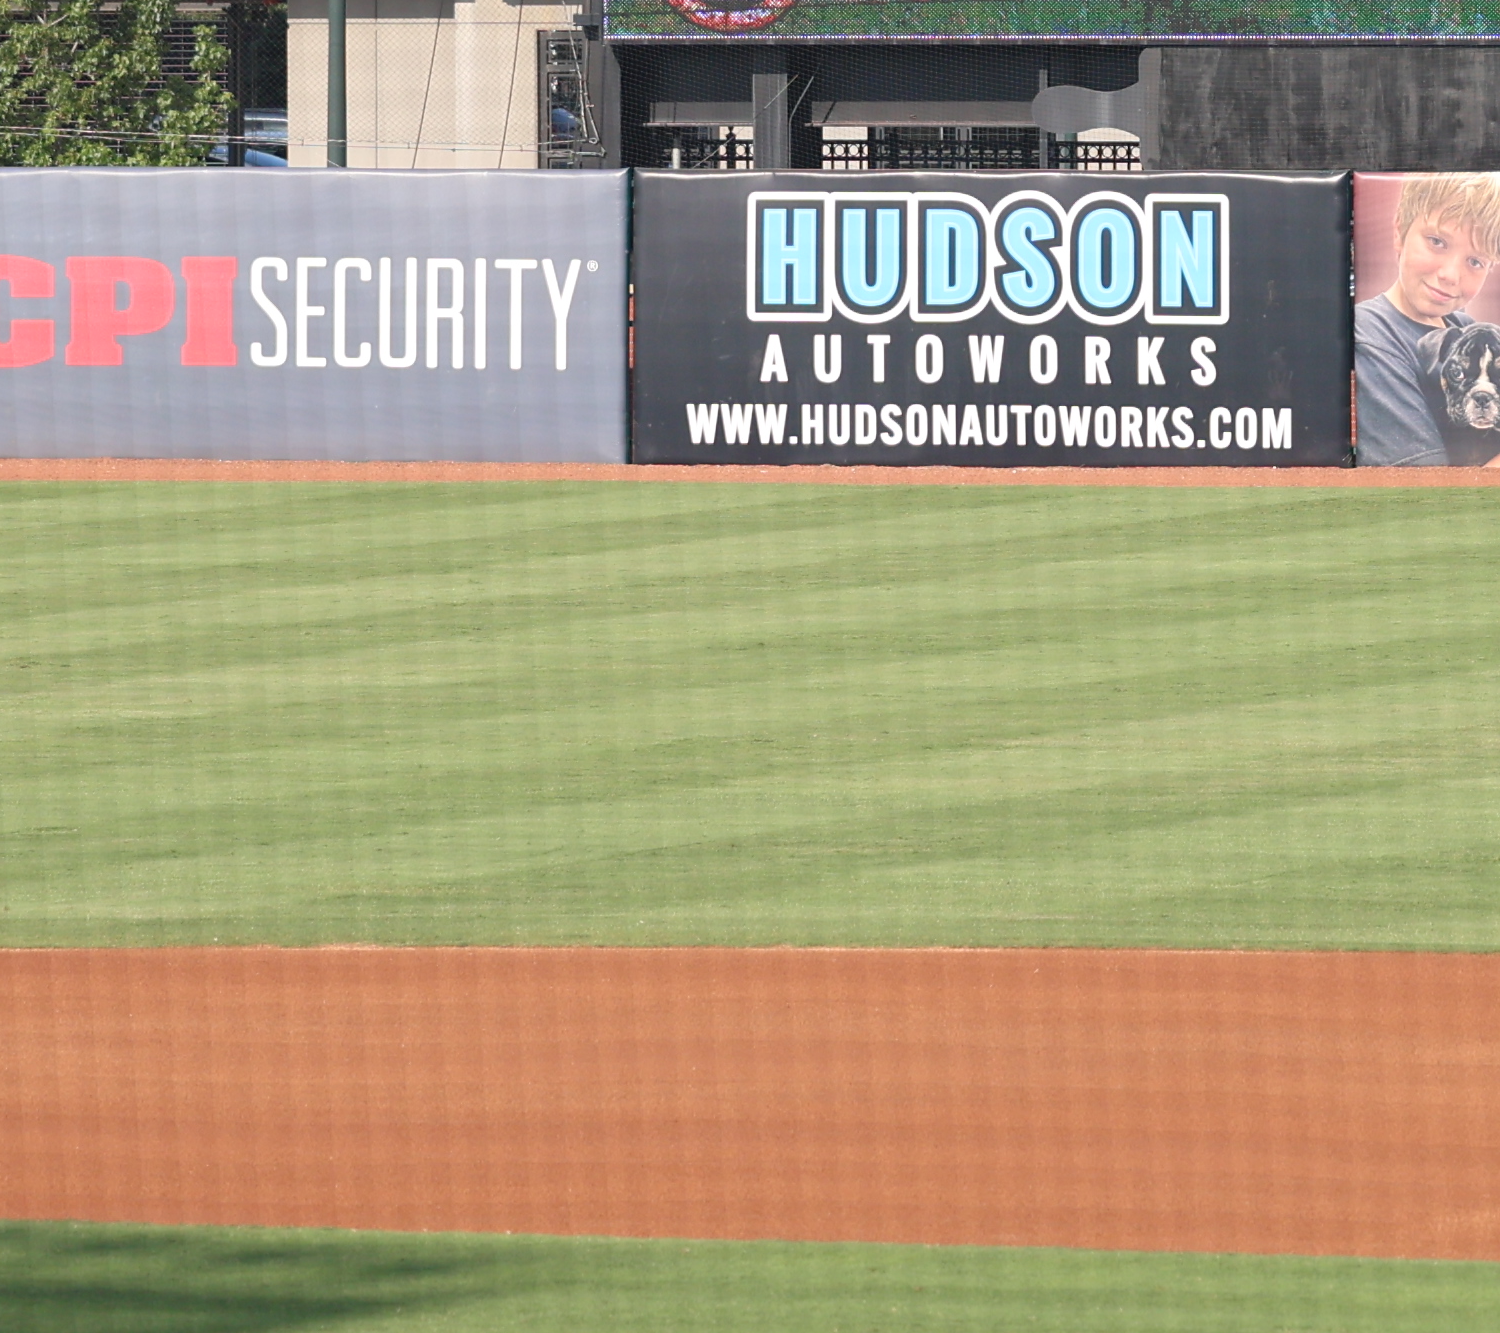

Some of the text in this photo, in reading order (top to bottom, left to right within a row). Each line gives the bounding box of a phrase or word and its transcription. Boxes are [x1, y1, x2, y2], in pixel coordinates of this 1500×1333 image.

[747, 190, 1229, 325] HUDSON
[250, 256, 582, 371] SECURITY
[760, 334, 1218, 387] AUTOWORKS
[686, 403, 1293, 450] WWW.HUDSONAUTOWORKS.COM
